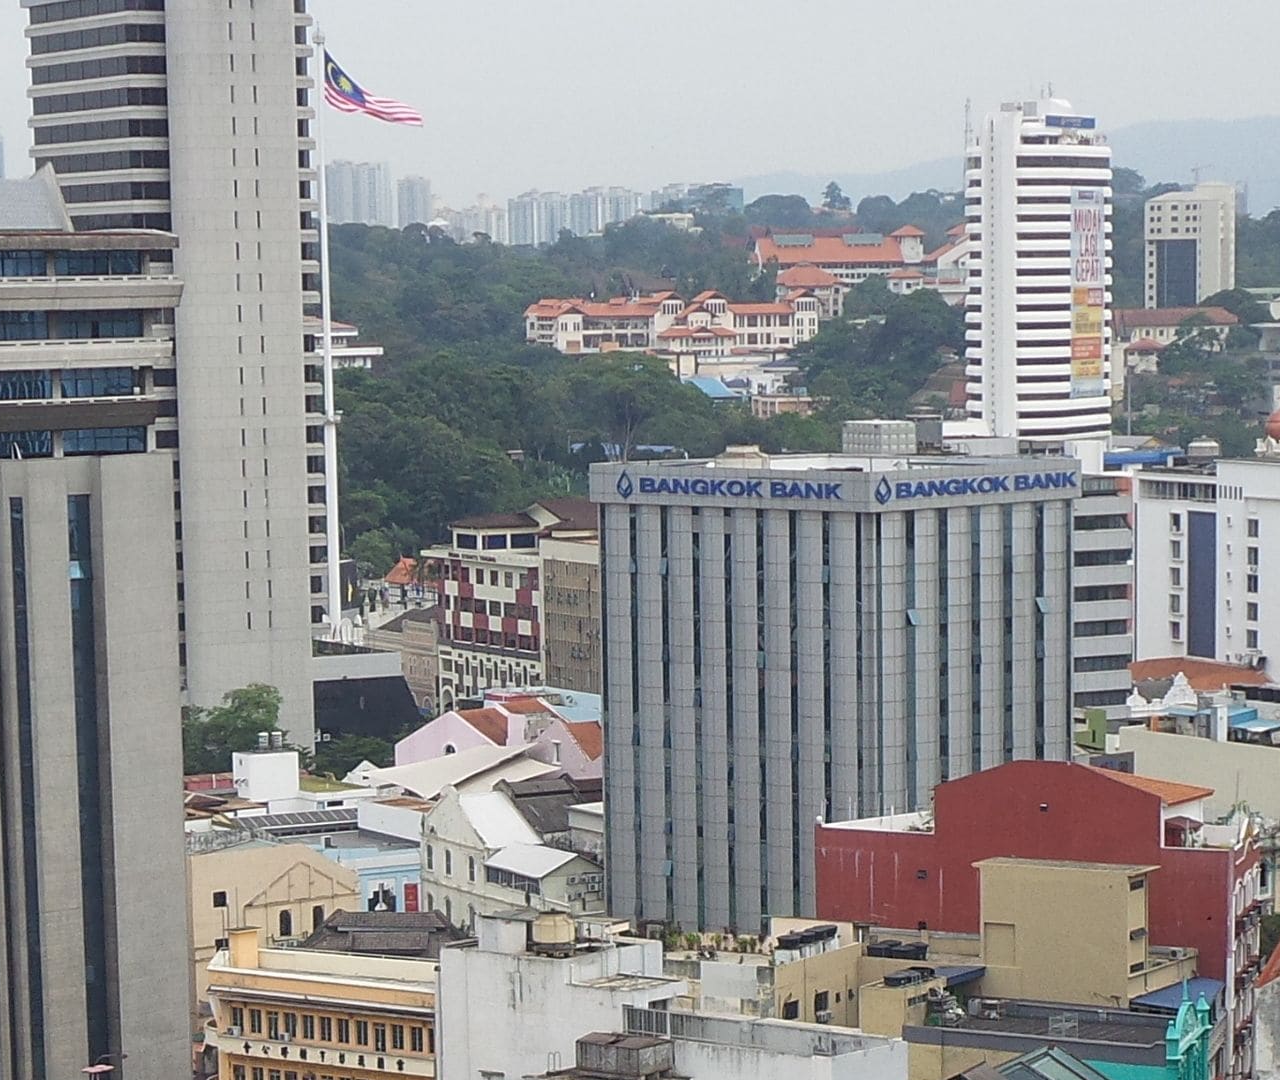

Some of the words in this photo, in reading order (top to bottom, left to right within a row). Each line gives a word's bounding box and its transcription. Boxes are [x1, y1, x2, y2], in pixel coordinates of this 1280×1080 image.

[639, 477, 764, 498] BANGKOK
[769, 481, 842, 500] BANK
[895, 475, 1010, 499] BANGKOK
[1014, 471, 1077, 492] BANK
